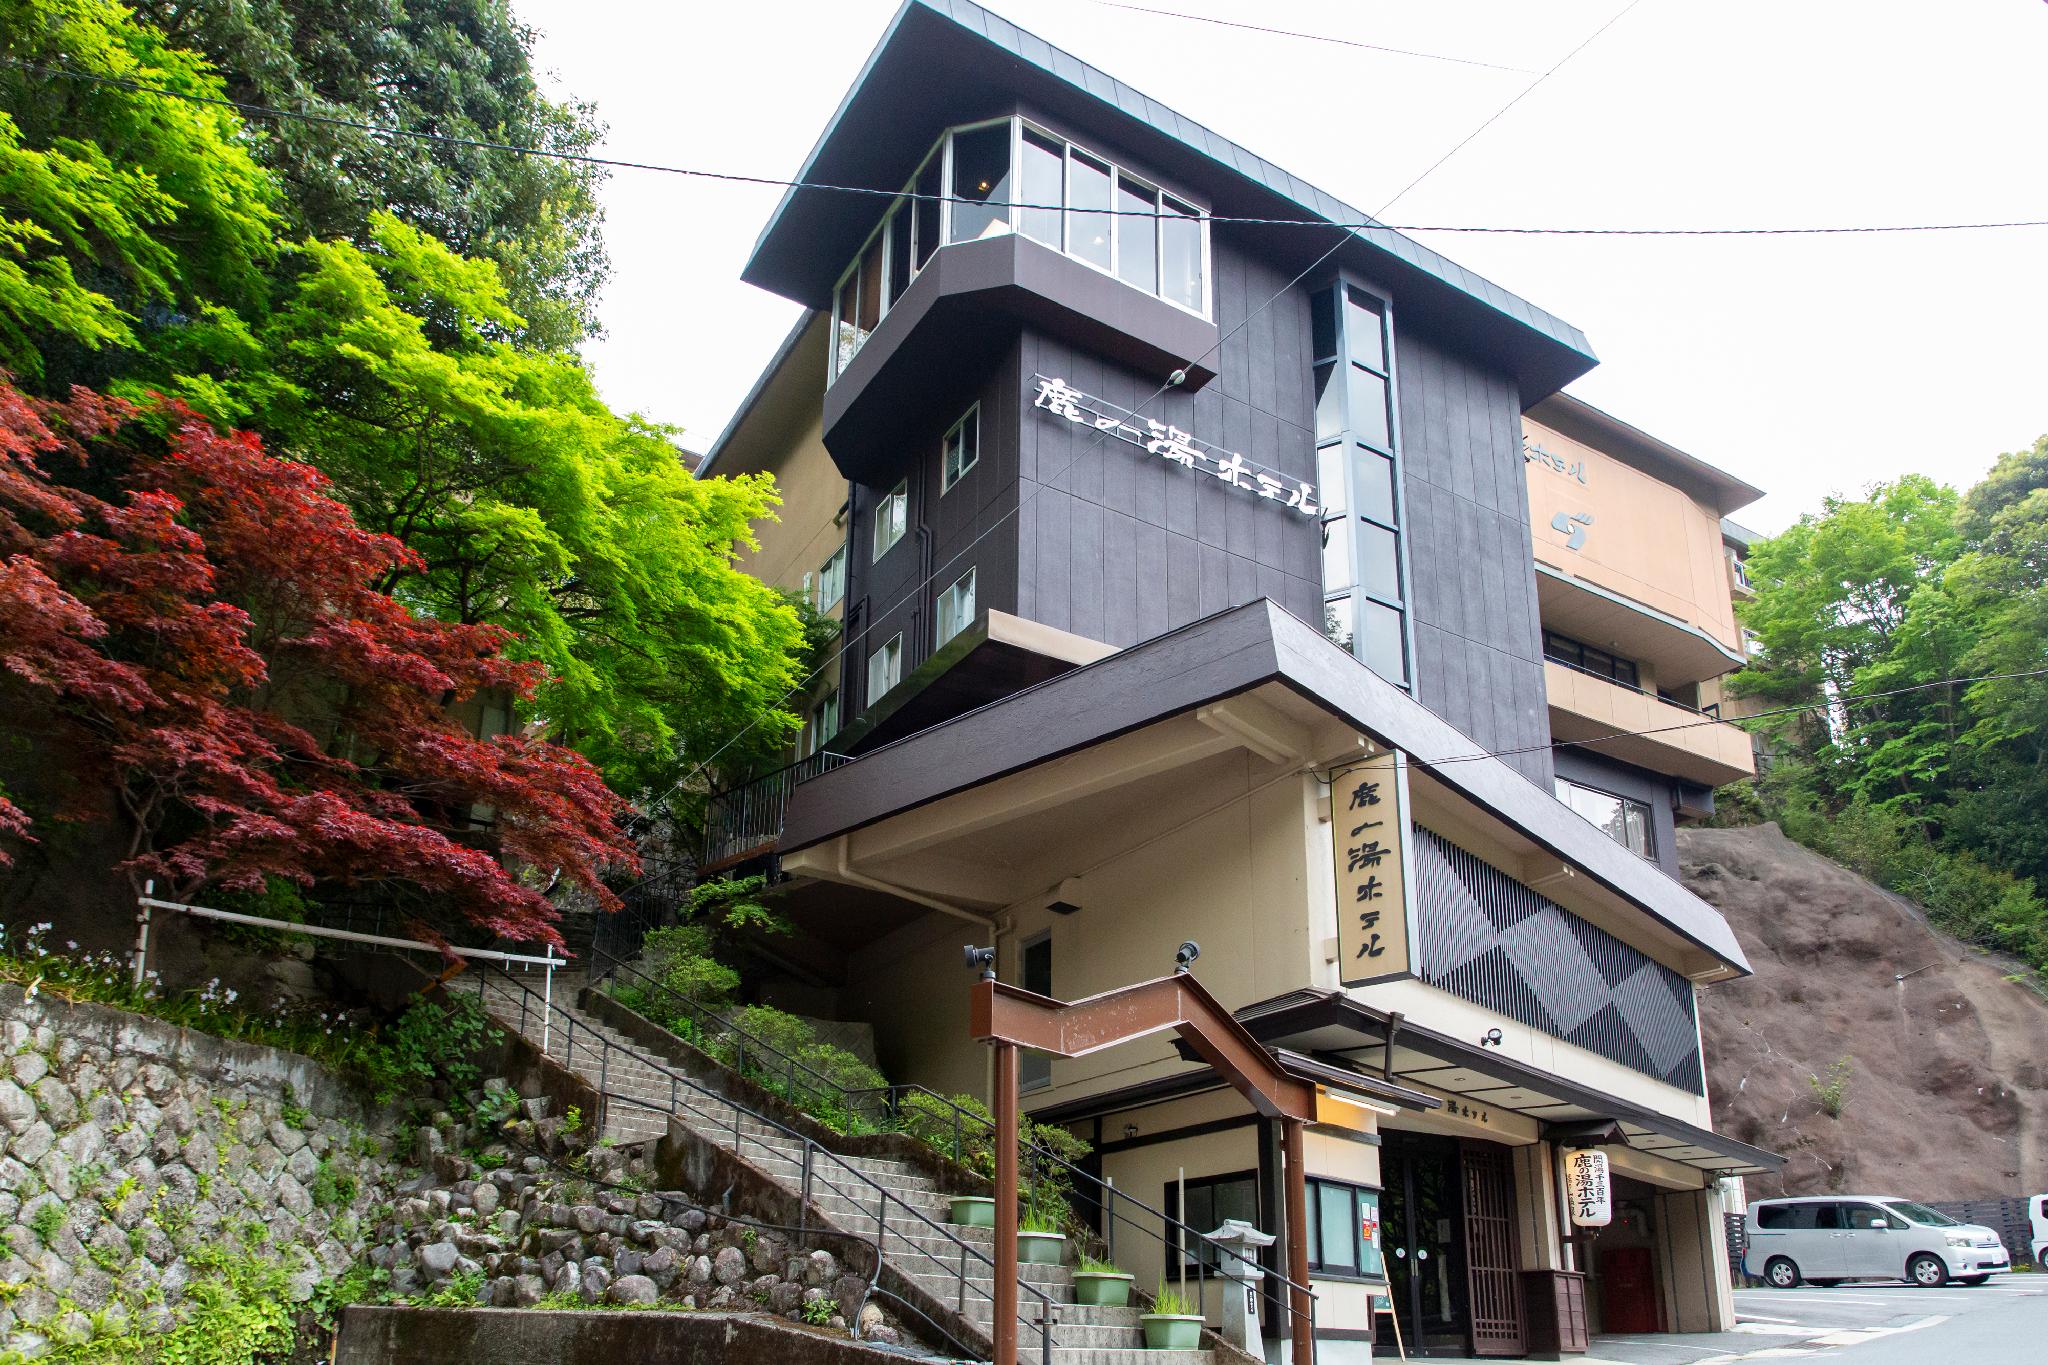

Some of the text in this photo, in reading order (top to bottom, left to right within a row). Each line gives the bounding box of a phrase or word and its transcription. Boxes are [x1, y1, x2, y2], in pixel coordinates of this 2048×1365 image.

[1034, 378, 1318, 515] 鹿の湯ホテル
[1522, 443, 1586, 485] ホテル
[1348, 782, 1391, 959] 鹿の湯ホテル
[1574, 1154, 1596, 1217] 鹿の湯ホテル
